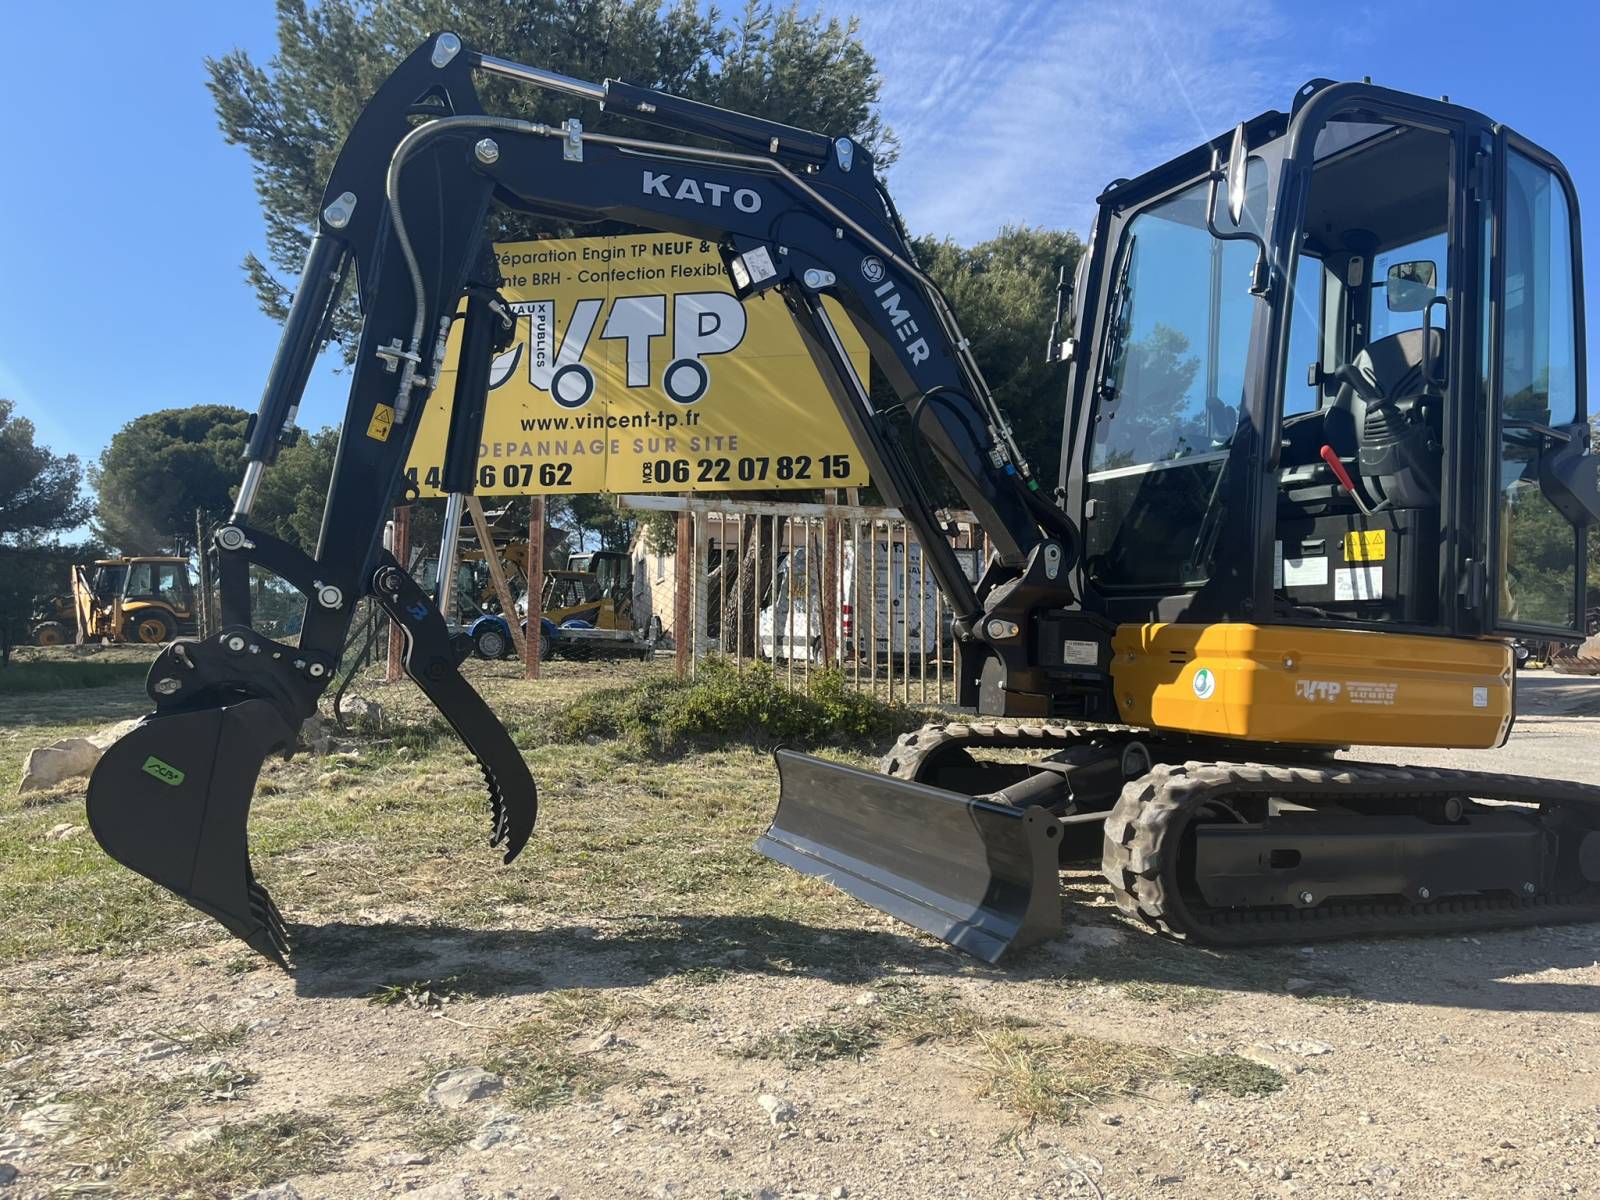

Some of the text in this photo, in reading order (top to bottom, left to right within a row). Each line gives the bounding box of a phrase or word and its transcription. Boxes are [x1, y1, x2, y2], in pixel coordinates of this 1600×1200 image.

[642, 170, 763, 213] KATO
[582, 245, 626, 262] Engin
[631, 244, 647, 257] TP
[652, 241, 693, 256] NEUF
[699, 240, 710, 253] &
[502, 274, 527, 287] nte
[532, 271, 560, 285] BRH
[578, 264, 665, 284] Confection
[874, 280, 930, 367] IMER
[537, 315, 545, 367] PUBLICS
[520, 409, 700, 431] www.vincent-tp.fr
[632, 437, 677, 454] SUR
[690, 435, 738, 452] SITE
[503, 464, 533, 487] 07
[540, 462, 573, 487] 62
[642, 455, 850, 484] MOB 06 22 07 82 15
